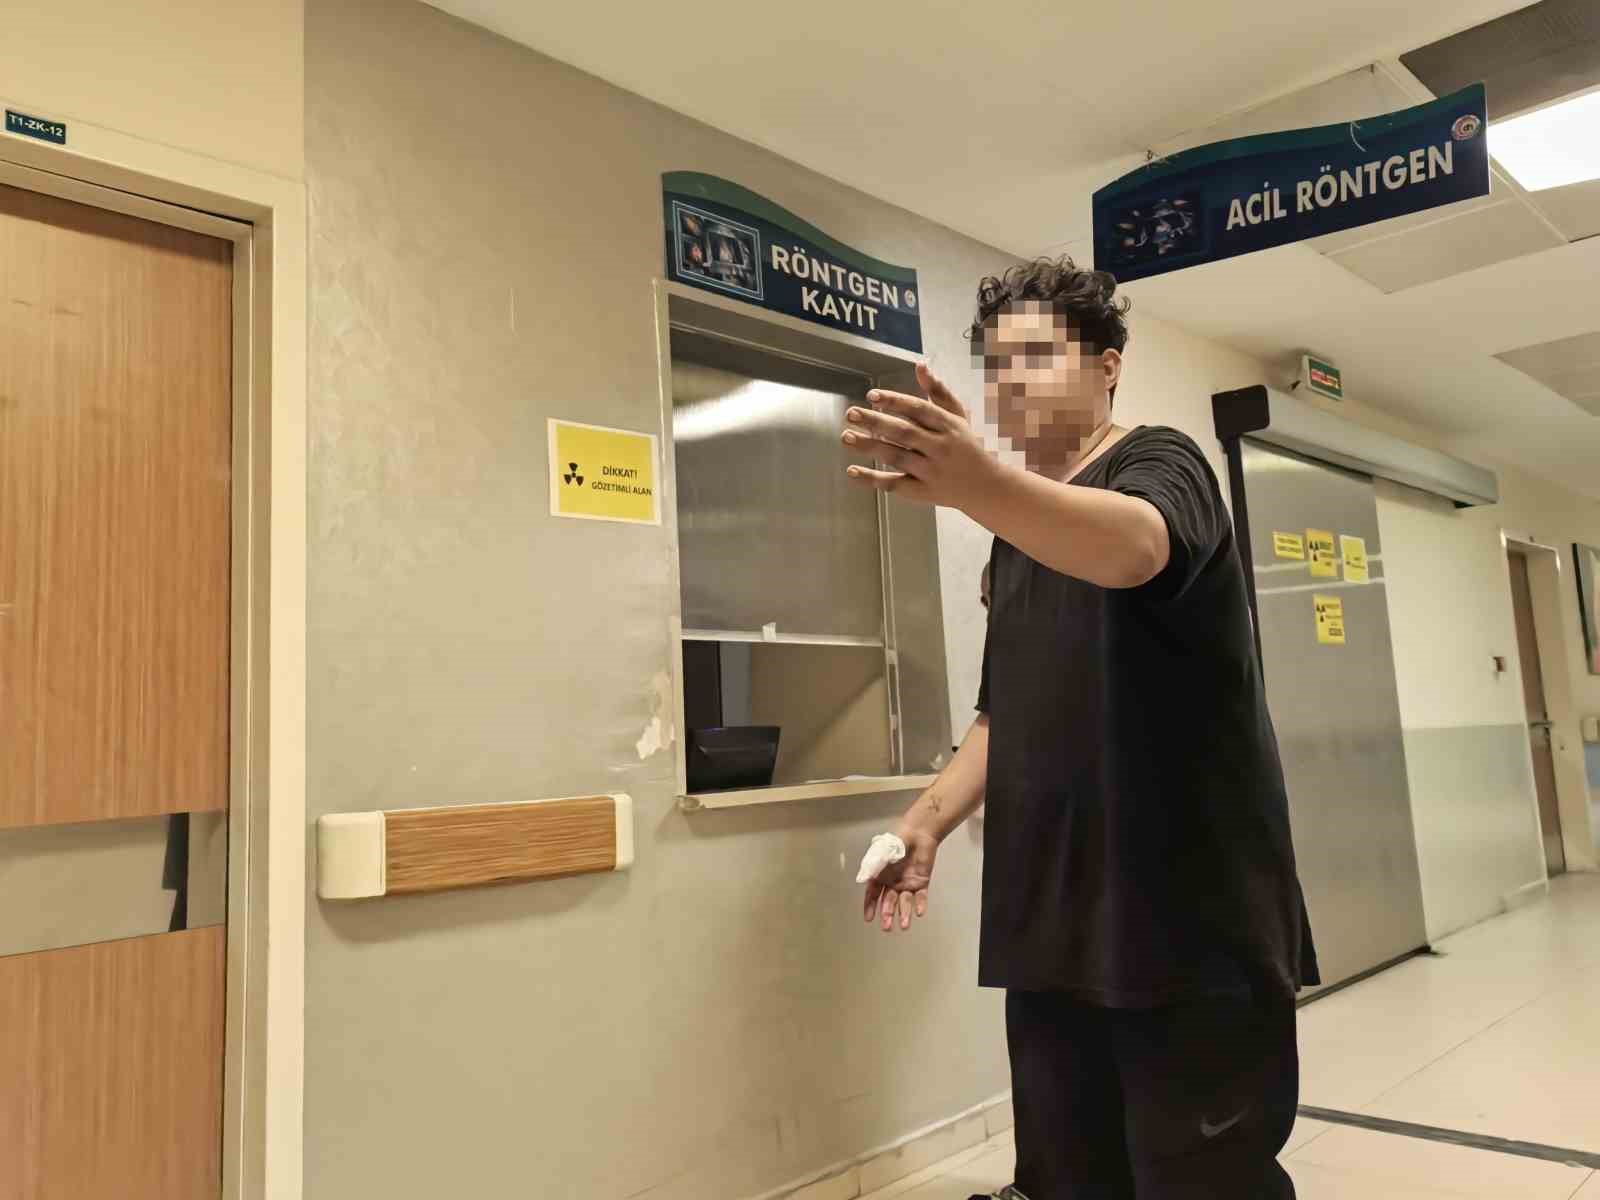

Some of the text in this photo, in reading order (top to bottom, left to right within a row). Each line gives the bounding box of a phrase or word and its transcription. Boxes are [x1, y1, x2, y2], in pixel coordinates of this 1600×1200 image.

[8, 113, 63, 137] T1-ZK-12
[1226, 141, 1454, 231] ACİL RÖNTGEN
[770, 244, 899, 309] RÖNTGEN
[801, 286, 879, 331] KAYIT
[602, 465, 638, 480] DİKKAT!
[633, 487, 652, 496] ALAN
